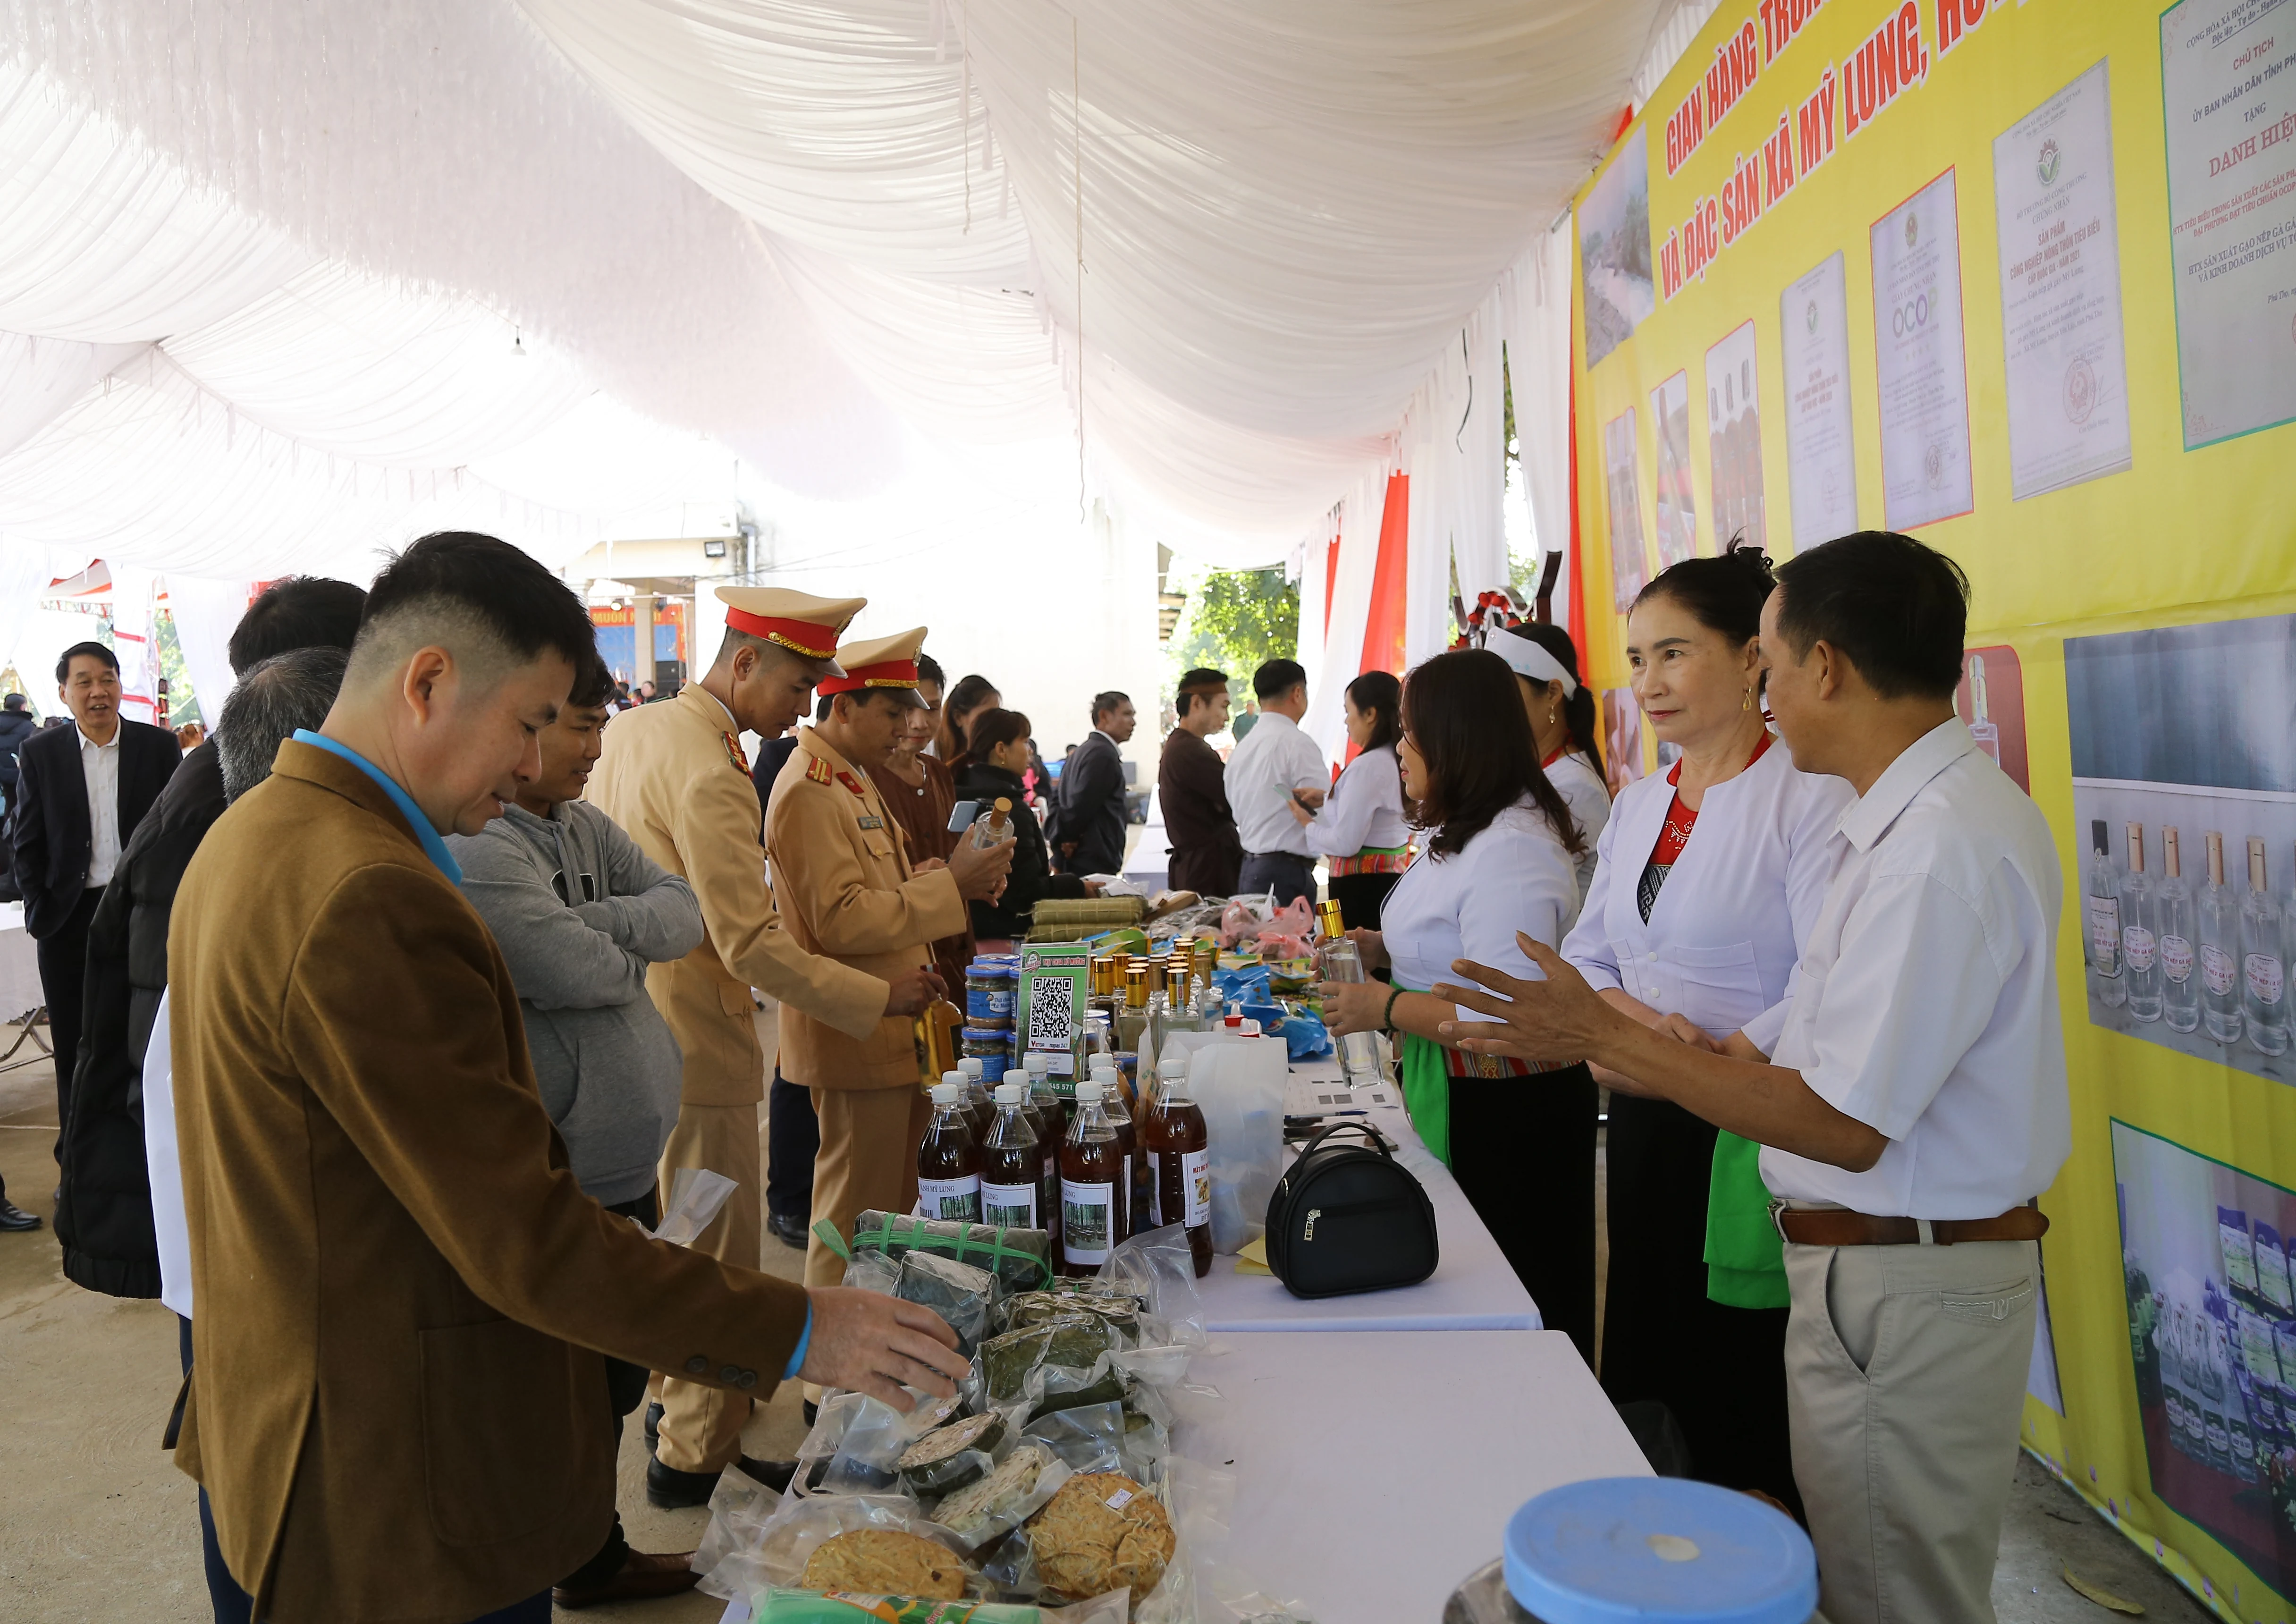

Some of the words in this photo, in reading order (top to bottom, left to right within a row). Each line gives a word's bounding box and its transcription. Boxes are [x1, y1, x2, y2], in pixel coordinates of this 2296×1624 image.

[2186, 30, 2204, 49] CỘNG
[2206, 20, 2219, 35] HÒA
[2221, 12, 2229, 26] XÃ
[2231, 3, 2244, 19] HỘI
[2246, 0, 2259, 8] CH
[2233, 47, 2250, 70] CHỦ
[2254, 37, 2273, 59] TỊCH
[1667, 85, 1702, 175] GIAN
[1706, 22, 1757, 130] HÀNG
[2193, 106, 2202, 122] ỦY
[2204, 99, 2219, 115] BAN
[2221, 83, 2242, 105] NHÂN
[2245, 73, 2261, 92] DÂN
[2264, 59, 2281, 81] TỈNH
[2244, 102, 2266, 124] TẶNG
[1660, 230, 1683, 300] VÀ
[1684, 199, 1717, 279] ĐẶC
[1722, 155, 1760, 244] SẢN
[1764, 115, 1794, 208] XÃ
[1799, 69, 1835, 176] MỸ
[1844, 1, 1927, 136] LUNG,
[2209, 137, 2256, 176] DANH
[2188, 261, 2202, 274] HTX
[2203, 254, 2216, 267] SẢN
[2218, 244, 2237, 261] XUẤT
[2239, 237, 2254, 254] GẠO
[2256, 228, 2271, 244] NẾP
[2272, 222, 2283, 237] GÀ
[2198, 270, 2208, 283] VÀ
[2210, 264, 2227, 278] KINH
[2228, 252, 2254, 270] DOANH
[2256, 243, 2274, 260] DỊCH
[2276, 237, 2286, 252] VỤ
[1893, 287, 1938, 338] OCOP
[593, 610, 625, 624] MUÔN
[1064, 1189, 1075, 1198] LUNG
